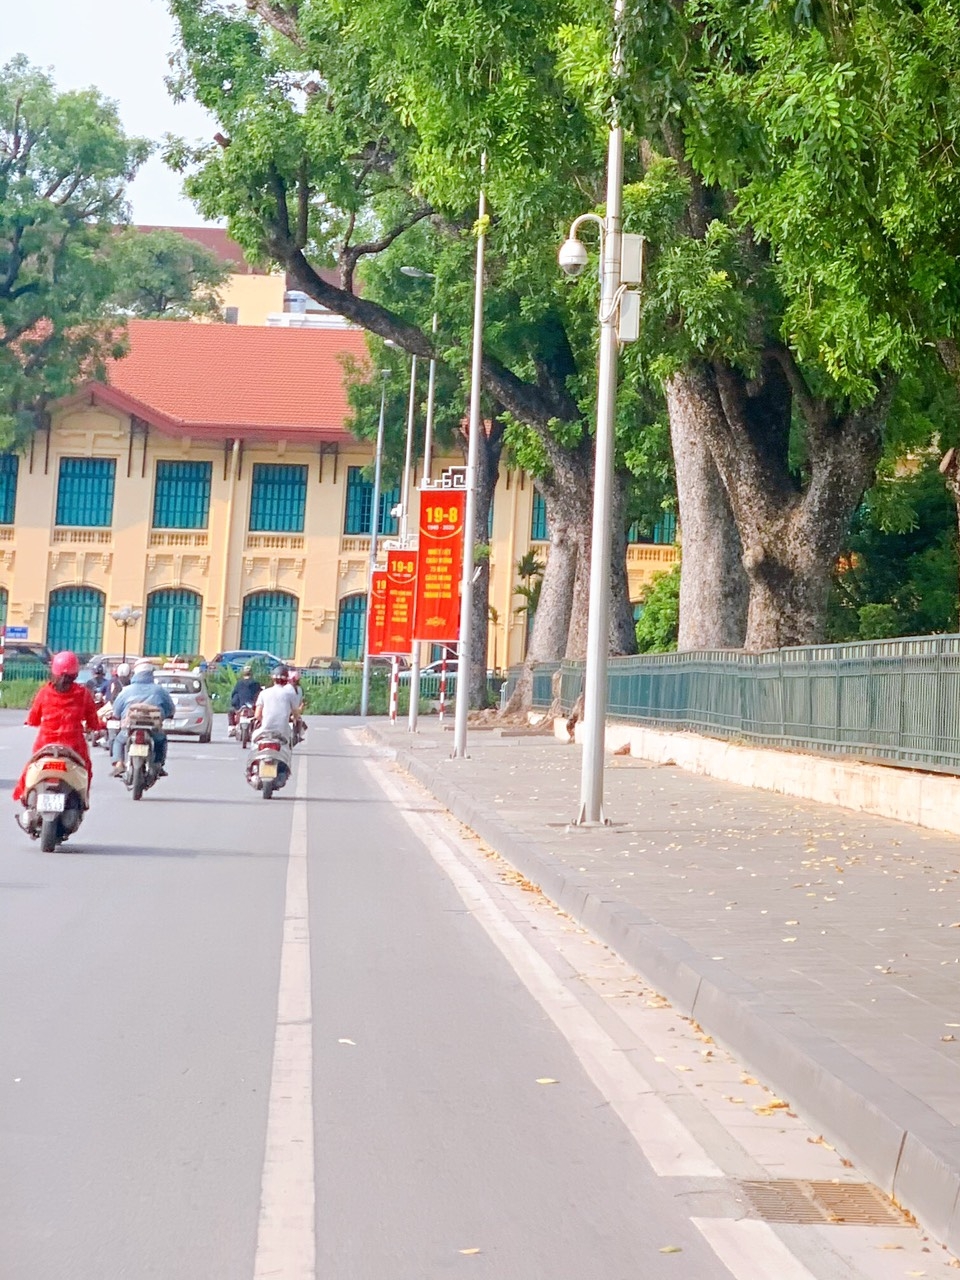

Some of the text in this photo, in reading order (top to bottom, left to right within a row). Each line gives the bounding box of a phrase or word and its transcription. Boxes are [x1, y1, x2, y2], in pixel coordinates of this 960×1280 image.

[426, 506, 458, 523] 19-8
[391, 560, 414, 573] 19-8
[376, 579, 387, 590] 19
